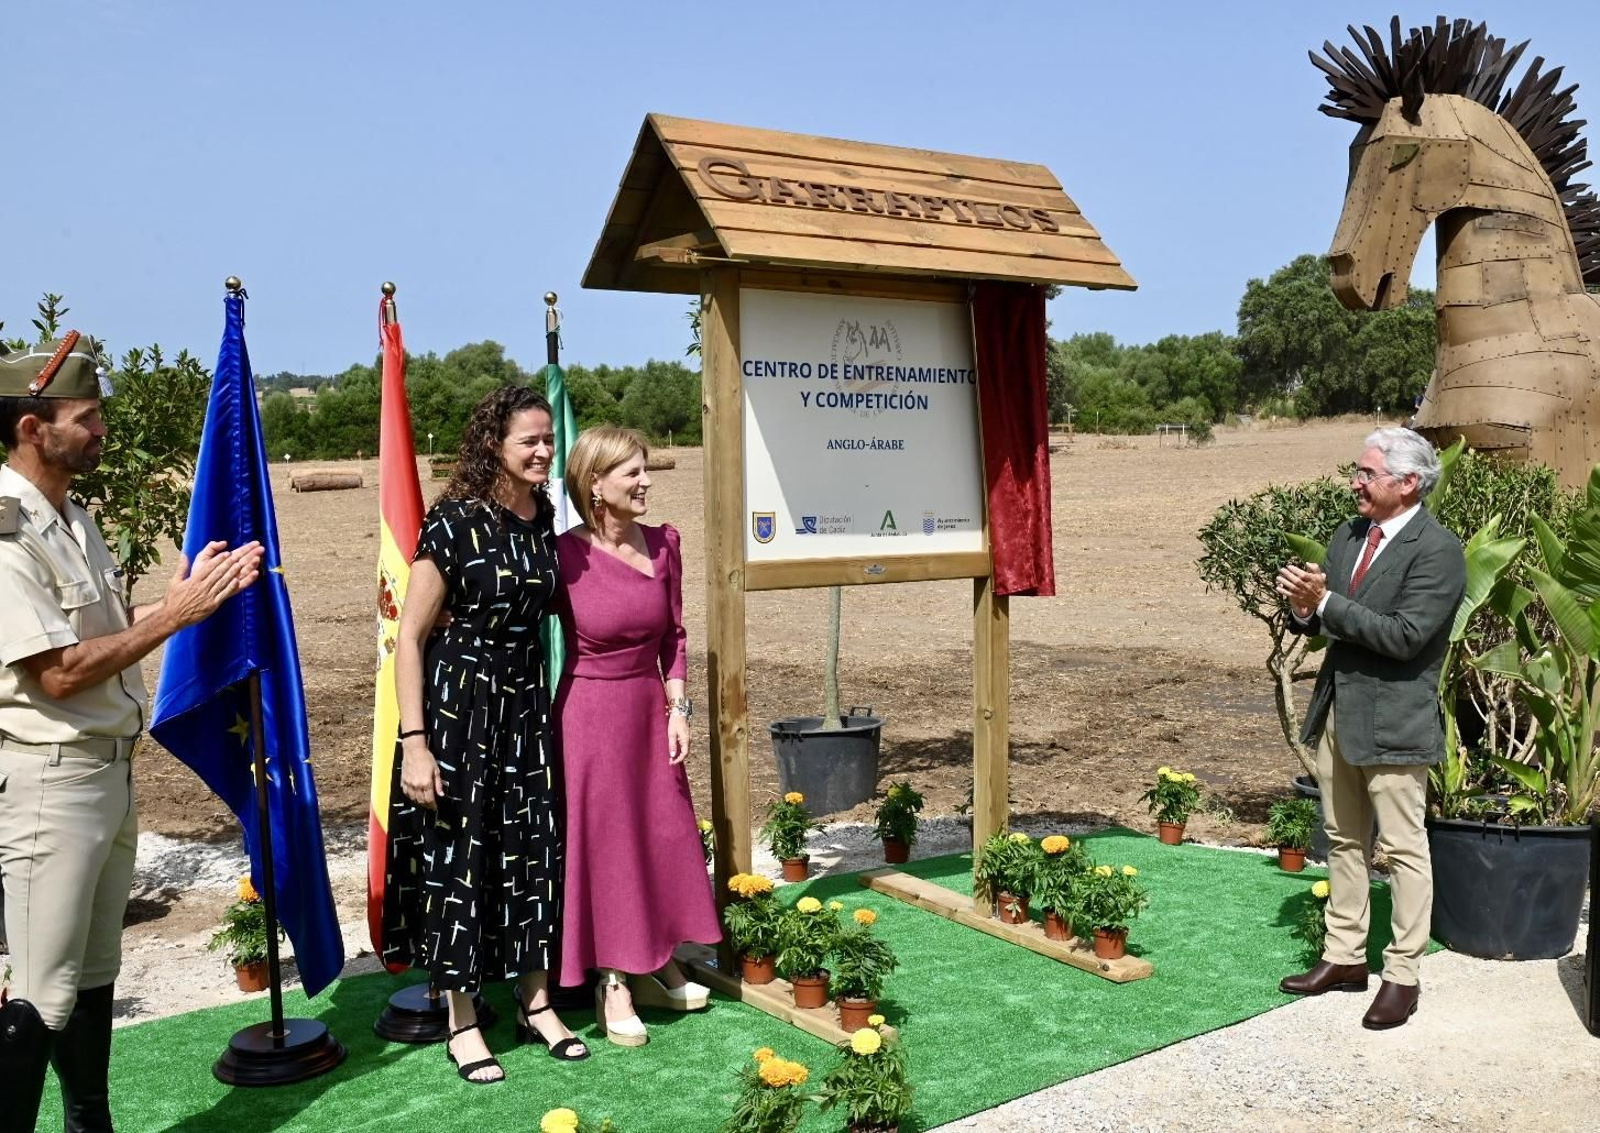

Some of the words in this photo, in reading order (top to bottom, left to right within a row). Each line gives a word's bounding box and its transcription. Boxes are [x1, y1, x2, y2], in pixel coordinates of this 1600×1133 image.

[697, 156, 1060, 232] GARRAPILOS
[743, 360, 812, 379] CENTRO
[818, 363, 838, 380] DE
[844, 364, 976, 385] ENTRENAMIENTO
[800, 391, 811, 408] Y
[816, 390, 928, 410] COMPETICIÓN
[827, 436, 904, 450] ANGLO-ÁRABE
